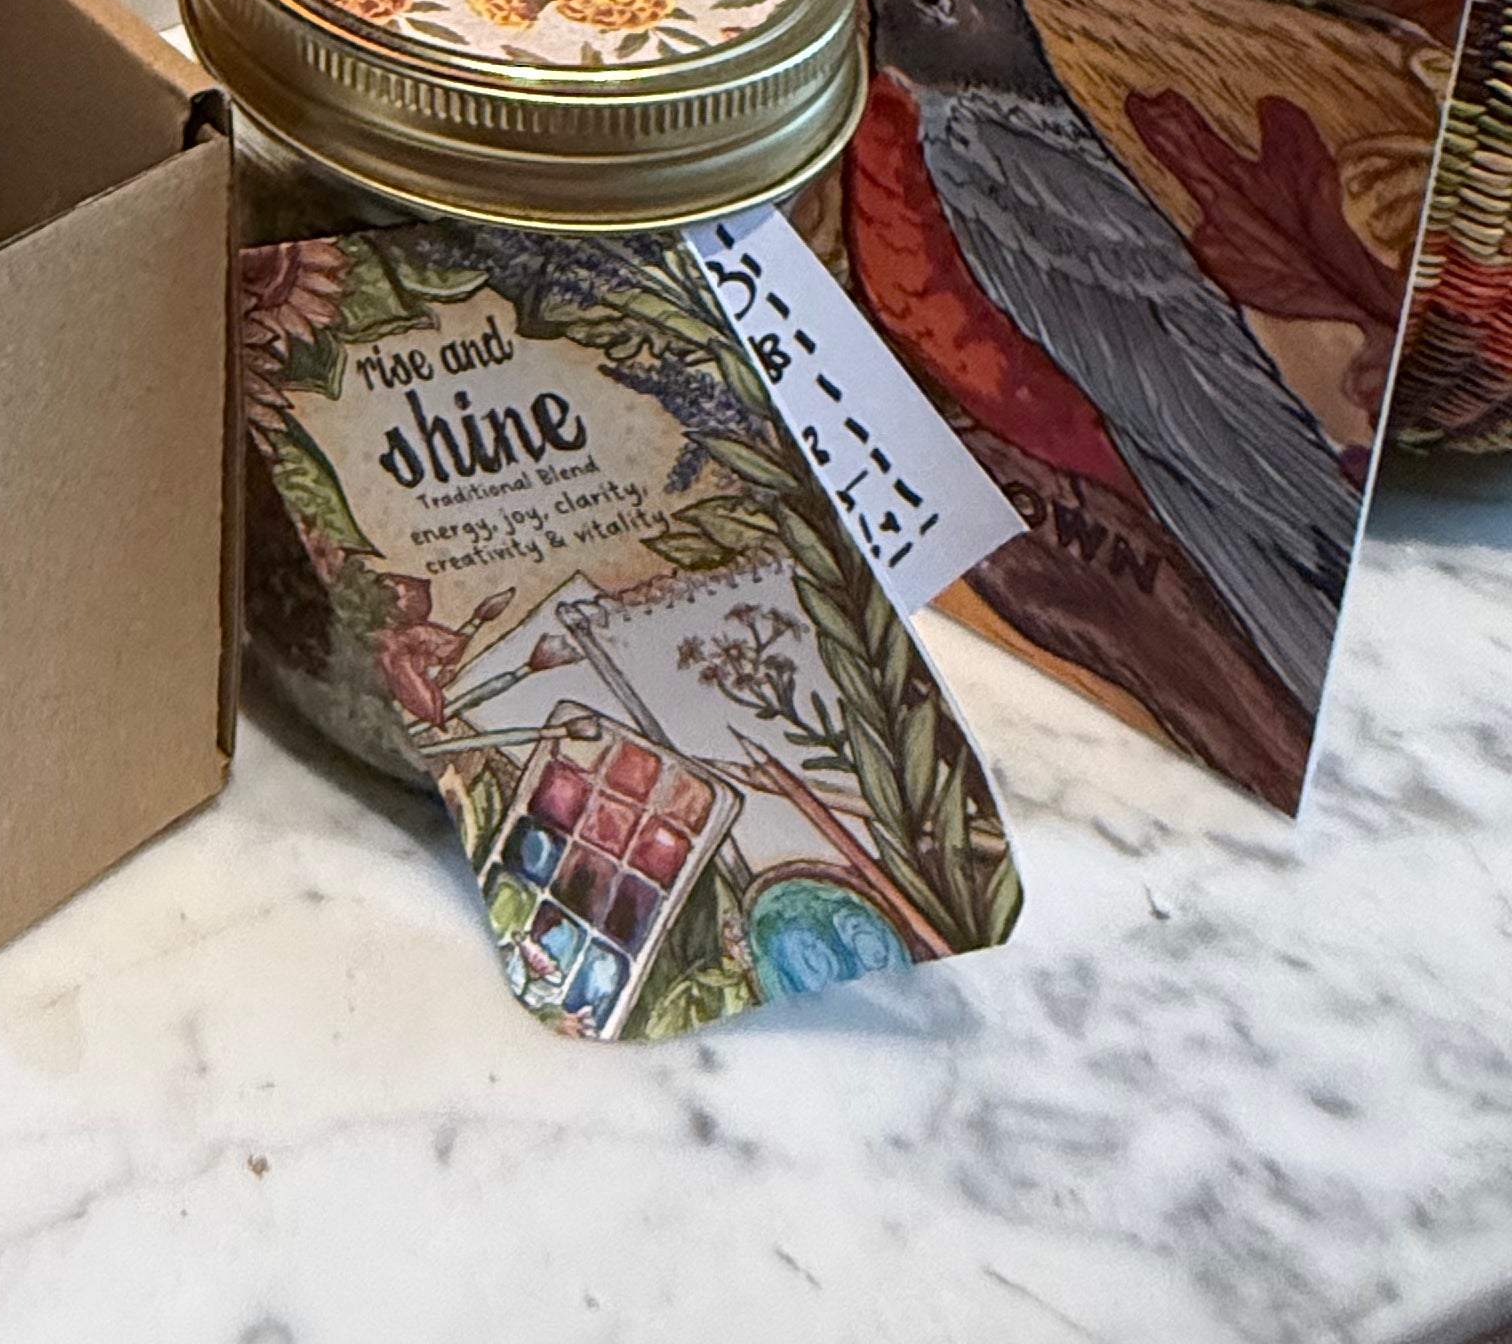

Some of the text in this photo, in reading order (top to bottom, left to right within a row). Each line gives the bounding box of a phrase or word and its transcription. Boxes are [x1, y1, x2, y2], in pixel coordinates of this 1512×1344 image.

[357, 314, 514, 391] rise and
[379, 389, 586, 488] shine
[416, 455, 601, 510] Traditional Blend
[554, 480, 648, 515] clarity,
[425, 507, 671, 575] creativity & vitality
